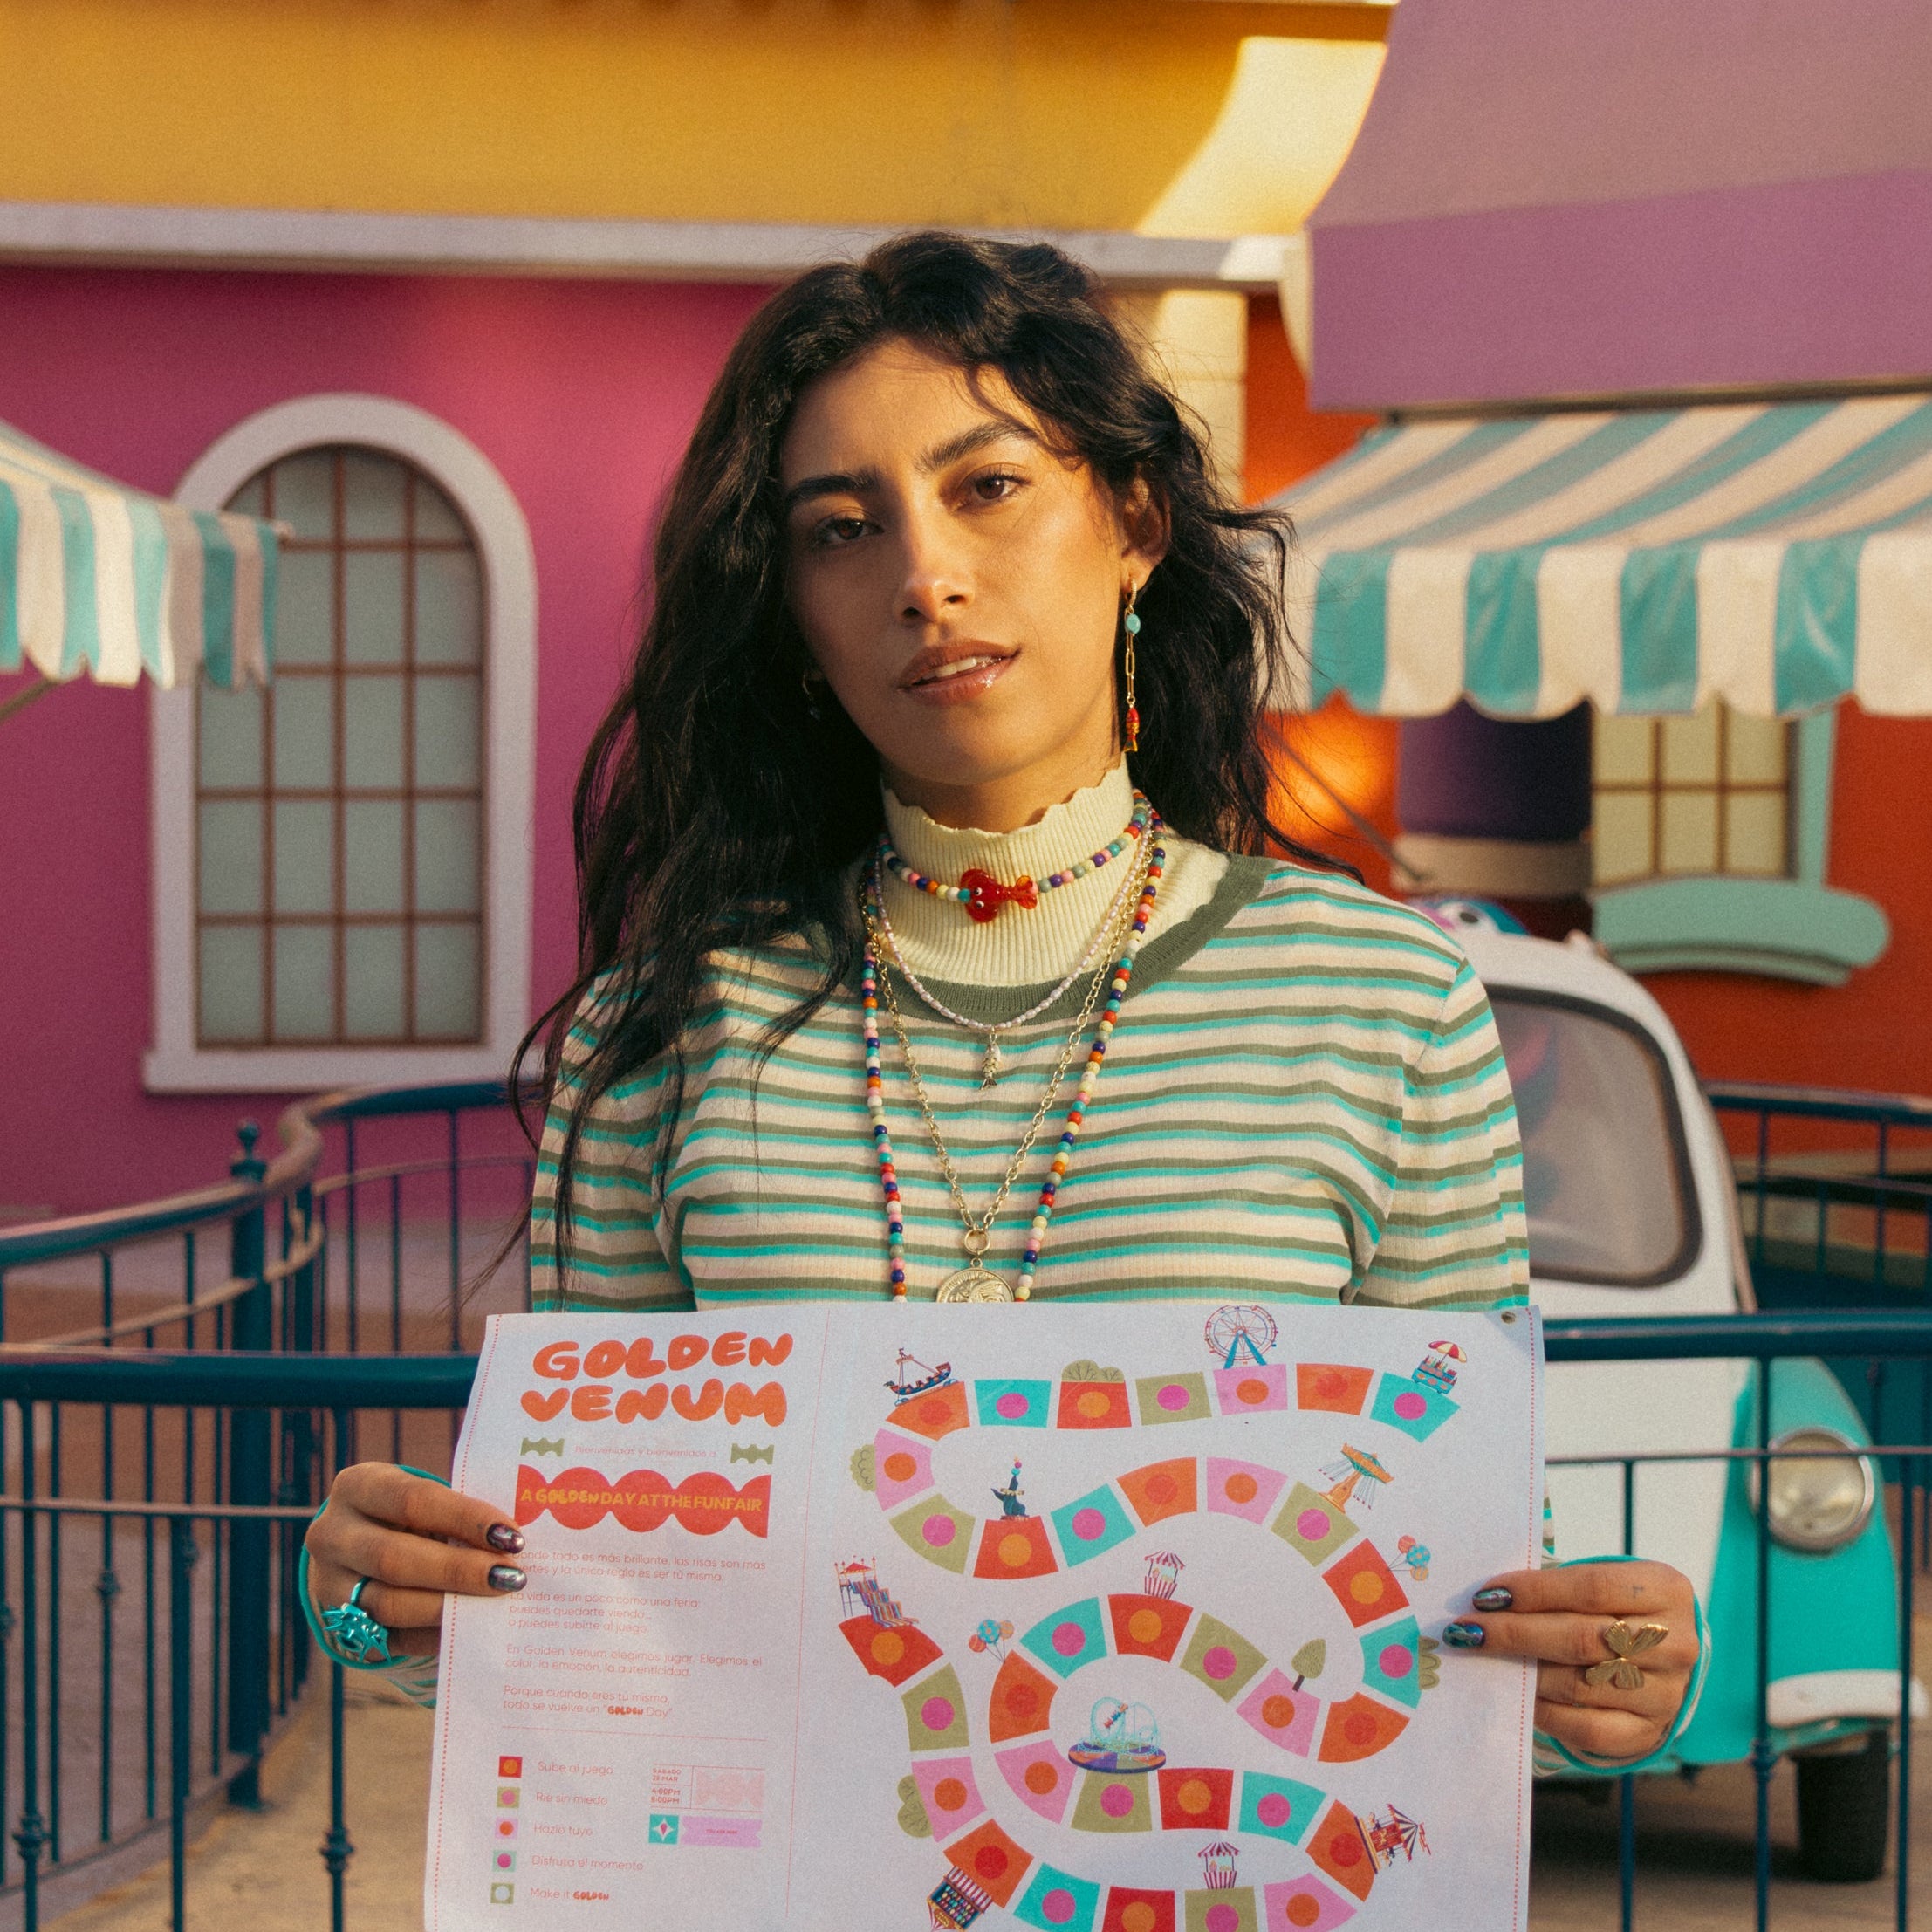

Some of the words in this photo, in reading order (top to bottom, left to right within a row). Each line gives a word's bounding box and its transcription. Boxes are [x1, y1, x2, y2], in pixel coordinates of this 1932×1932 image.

[533, 1331, 793, 1381] GOLDEN
[520, 1378, 787, 1427] VENUM
[521, 1489, 532, 1502] A
[535, 1488, 599, 1505] GOLDEN
[600, 1492, 636, 1505] DAY
[637, 1493, 660, 1507] AT
[661, 1494, 692, 1509] THE
[694, 1496, 762, 1511] FUNFAIR
[553, 1552, 579, 1561] todo
[582, 1553, 594, 1562] es
[674, 1556, 689, 1566] las
[693, 1558, 717, 1568] risas
[721, 1559, 740, 1569] son
[552, 1565, 558, 1576] y
[561, 1565, 572, 1575] la
[638, 1570, 650, 1579] es
[654, 1570, 669, 1579] ser
[526, 1591, 551, 1601] vida
[553, 1593, 565, 1602] es
[569, 1593, 581, 1602] un
[584, 1594, 613, 1605] poco
[616, 1596, 647, 1606] como
[649, 1598, 671, 1607] una
[509, 1604, 551, 1615] puedes
[553, 1607, 605, 1619] quedarte
[508, 1619, 516, 1627] o
[518, 1619, 560, 1630] puedes
[563, 1620, 600, 1630] subirte
[603, 1620, 613, 1631] al
[506, 1643, 520, 1655] En
[524, 1644, 565, 1655] Golden
[568, 1647, 606, 1658] Venum
[611, 1648, 661, 1662] elegimos
[700, 1653, 749, 1667] Elegimos
[751, 1655, 763, 1666] el
[538, 1658, 549, 1668] la
[605, 1661, 615, 1673] la
[504, 1684, 543, 1697] Porque
[545, 1688, 588, 1699] cuando
[592, 1691, 615, 1701] eres
[503, 1699, 530, 1710] todo
[532, 1702, 545, 1711] se
[548, 1702, 584, 1713] vuelve
[586, 1705, 599, 1714] un
[538, 1761, 566, 1773] Sube
[569, 1763, 579, 1773] al
[581, 1763, 614, 1777] juego
[556, 1793, 570, 1803] sin
[572, 1794, 608, 1805] miedo
[533, 1823, 565, 1834] Hazlo
[568, 1825, 593, 1837] tuyo
[531, 1855, 575, 1867] Disfruta
[578, 1857, 587, 1868] el
[591, 1860, 644, 1872] momento
[530, 1887, 560, 1899] Make
[563, 1887, 571, 1899] it
[572, 1890, 610, 1901] GOLDEN
